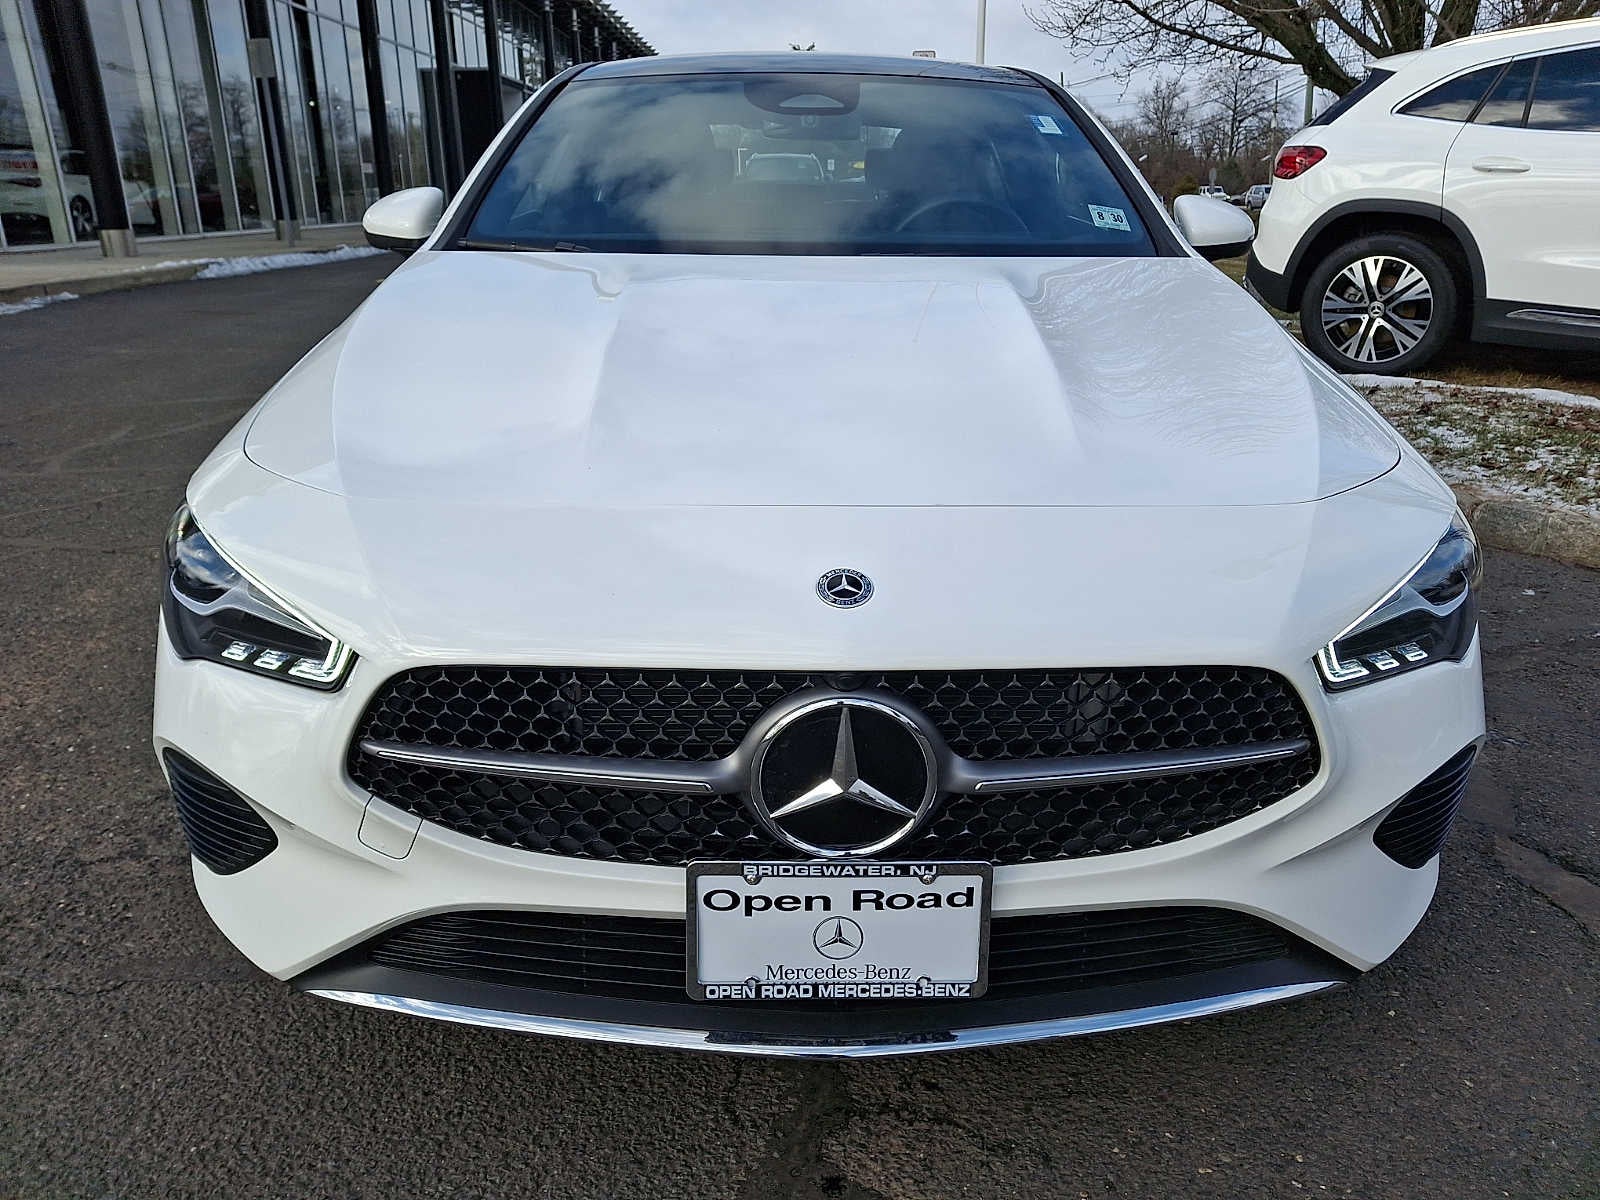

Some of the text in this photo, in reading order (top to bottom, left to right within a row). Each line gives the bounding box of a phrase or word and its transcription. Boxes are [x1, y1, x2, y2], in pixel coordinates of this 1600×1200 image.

[1097, 211, 1124, 223] 8 30
[743, 865, 937, 876] BRIDGEWATER, NJ
[702, 886, 975, 917] Open Road
[765, 963, 912, 980] Mercedes-Benz
[705, 984, 756, 999] OPEN
[761, 984, 813, 999] ROAD
